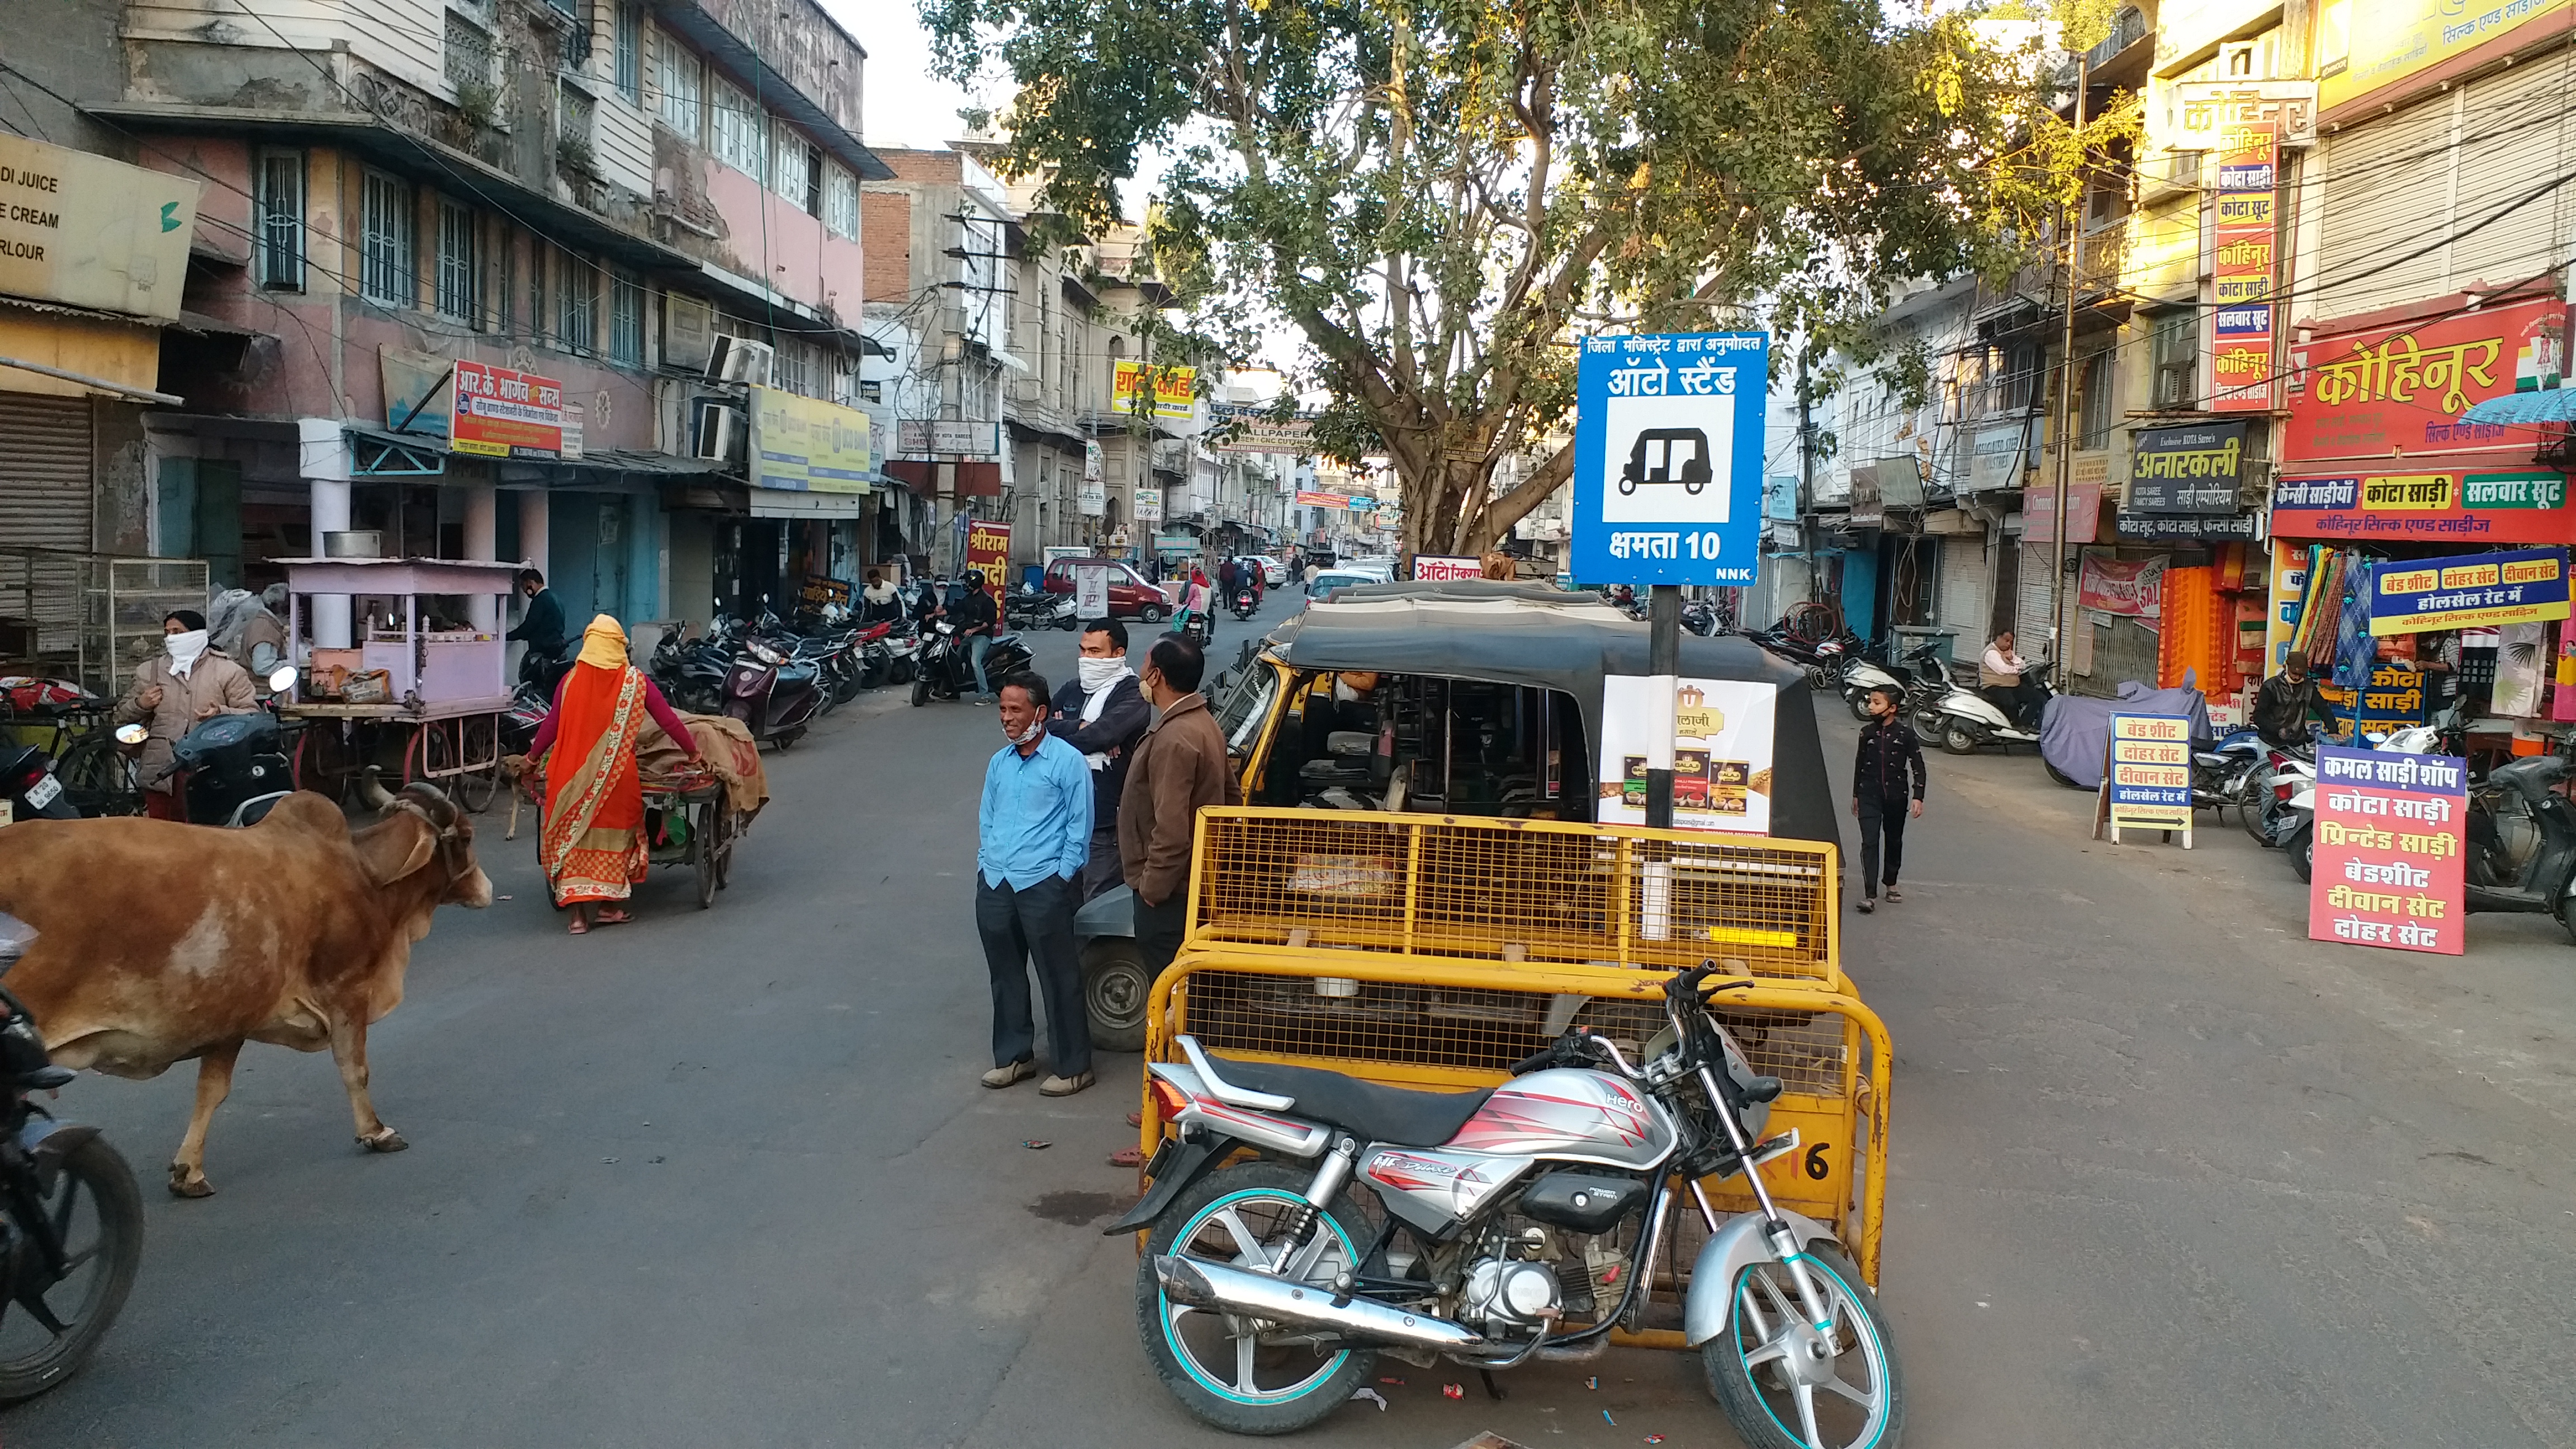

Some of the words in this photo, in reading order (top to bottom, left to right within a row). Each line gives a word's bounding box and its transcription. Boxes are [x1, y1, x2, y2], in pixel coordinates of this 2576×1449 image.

[2442, 20, 2475, 46] सिल्क
[2478, 7, 2502, 32] एण्ड
[2220, 126, 2273, 162] कोहिनूर
[18, 172, 58, 192] JUICE
[2220, 166, 2246, 187] कोटा
[11, 205, 59, 229] CREAM
[2220, 197, 2250, 216] कोटा
[2251, 200, 2270, 220] सूट
[2218, 238, 2271, 272] कोहिनूर
[2218, 278, 2243, 297] कोटा
[2244, 277, 2269, 299] साड़ी
[2218, 311, 2251, 328] सलवार
[2252, 310, 2268, 331] सूट
[1587, 336, 1616, 354] जिला
[1677, 335, 1704, 353] द्वारा
[1607, 357, 1669, 396] ऑटो
[1678, 356, 1737, 395] स्टैंड
[2216, 348, 2269, 380] कोहिनूर
[2316, 332, 2504, 414] कोहिनूर
[500, 371, 529, 402] भार्गव
[538, 385, 560, 407] सन्स
[2160, 436, 2182, 447] Exclusive
[2182, 434, 2197, 444] KOTA
[2425, 420, 2451, 443] सिल्क
[2135, 437, 2241, 479] अनारकली
[2134, 498, 2147, 506] FANCY
[2148, 497, 2166, 506] SAREES
[2135, 487, 2147, 495] KOTA
[2147, 486, 2161, 495] SAREE
[2176, 483, 2195, 508] साड़ी
[2195, 482, 2233, 508] एम्पोरियम
[2276, 479, 2309, 504] फैन्सी
[2366, 479, 2406, 503] कोटा
[2408, 477, 2449, 509] साड़ी
[2466, 480, 2529, 503] सलवार
[2531, 479, 2563, 510] सूट
[2119, 516, 2138, 533] कोटा
[2230, 514, 2253, 537] साड़ी
[2316, 515, 2363, 536] कोहिनूर
[2364, 514, 2401, 531] सिल्क
[2405, 518, 2436, 533] एण्ड
[2438, 515, 2491, 537] साड़ीज
[970, 528, 1008, 552] श्रीराम
[1609, 531, 1679, 560] क्षमता
[1684, 531, 1720, 560] 10
[1416, 560, 1449, 581] ऑटो
[1716, 568, 1751, 580] NNK
[2386, 576, 2405, 592] बेड
[2407, 574, 2433, 590] शीट
[2444, 570, 2475, 586] दोहर
[2476, 568, 2497, 584] सेट
[2504, 565, 2538, 581] दीवान
[2539, 562, 2557, 579] सेट
[2417, 591, 2482, 611] होलसेल
[2483, 589, 2506, 604] रेट
[2507, 586, 2524, 603] में
[2402, 616, 2444, 626] कोहिनूर
[2445, 613, 2475, 622] सिल्क
[2477, 611, 2500, 620] एण्ड
[2371, 666, 2425, 688] कोटा
[2365, 688, 2422, 713] साड़ी
[1677, 713, 1710, 727] ालाजी
[2127, 720, 2147, 737] बेड
[2150, 721, 2177, 738] शीट
[2123, 744, 2156, 761] दोहर
[2158, 745, 2180, 761] सेट
[2119, 766, 2160, 784] दीवान
[2163, 768, 2184, 785] सेट
[2324, 757, 2375, 780] कमल
[2375, 757, 2419, 789] साड़ी
[2419, 760, 2459, 788] शॉप
[2119, 788, 2161, 801] होलसेल
[2161, 789, 2175, 802] रेट
[2176, 789, 2187, 803] में
[2327, 789, 2390, 816] कोटा
[2393, 797, 2452, 826] साड़ी
[2320, 821, 2395, 850] प्रिन्टेड
[2398, 832, 2459, 861] साड़ी
[2343, 857, 2431, 888] बेडशीट
[2327, 884, 2402, 915] दीवान
[2405, 892, 2447, 919] सेट
[2333, 914, 2394, 943] दोहर
[2397, 920, 2438, 947] सेट
[1606, 1093, 1644, 1113] Hero
[1403, 1161, 1453, 1174] Deluxe
[1805, 1142, 1830, 1180] 6
[1589, 1187, 1616, 1195] POWER
